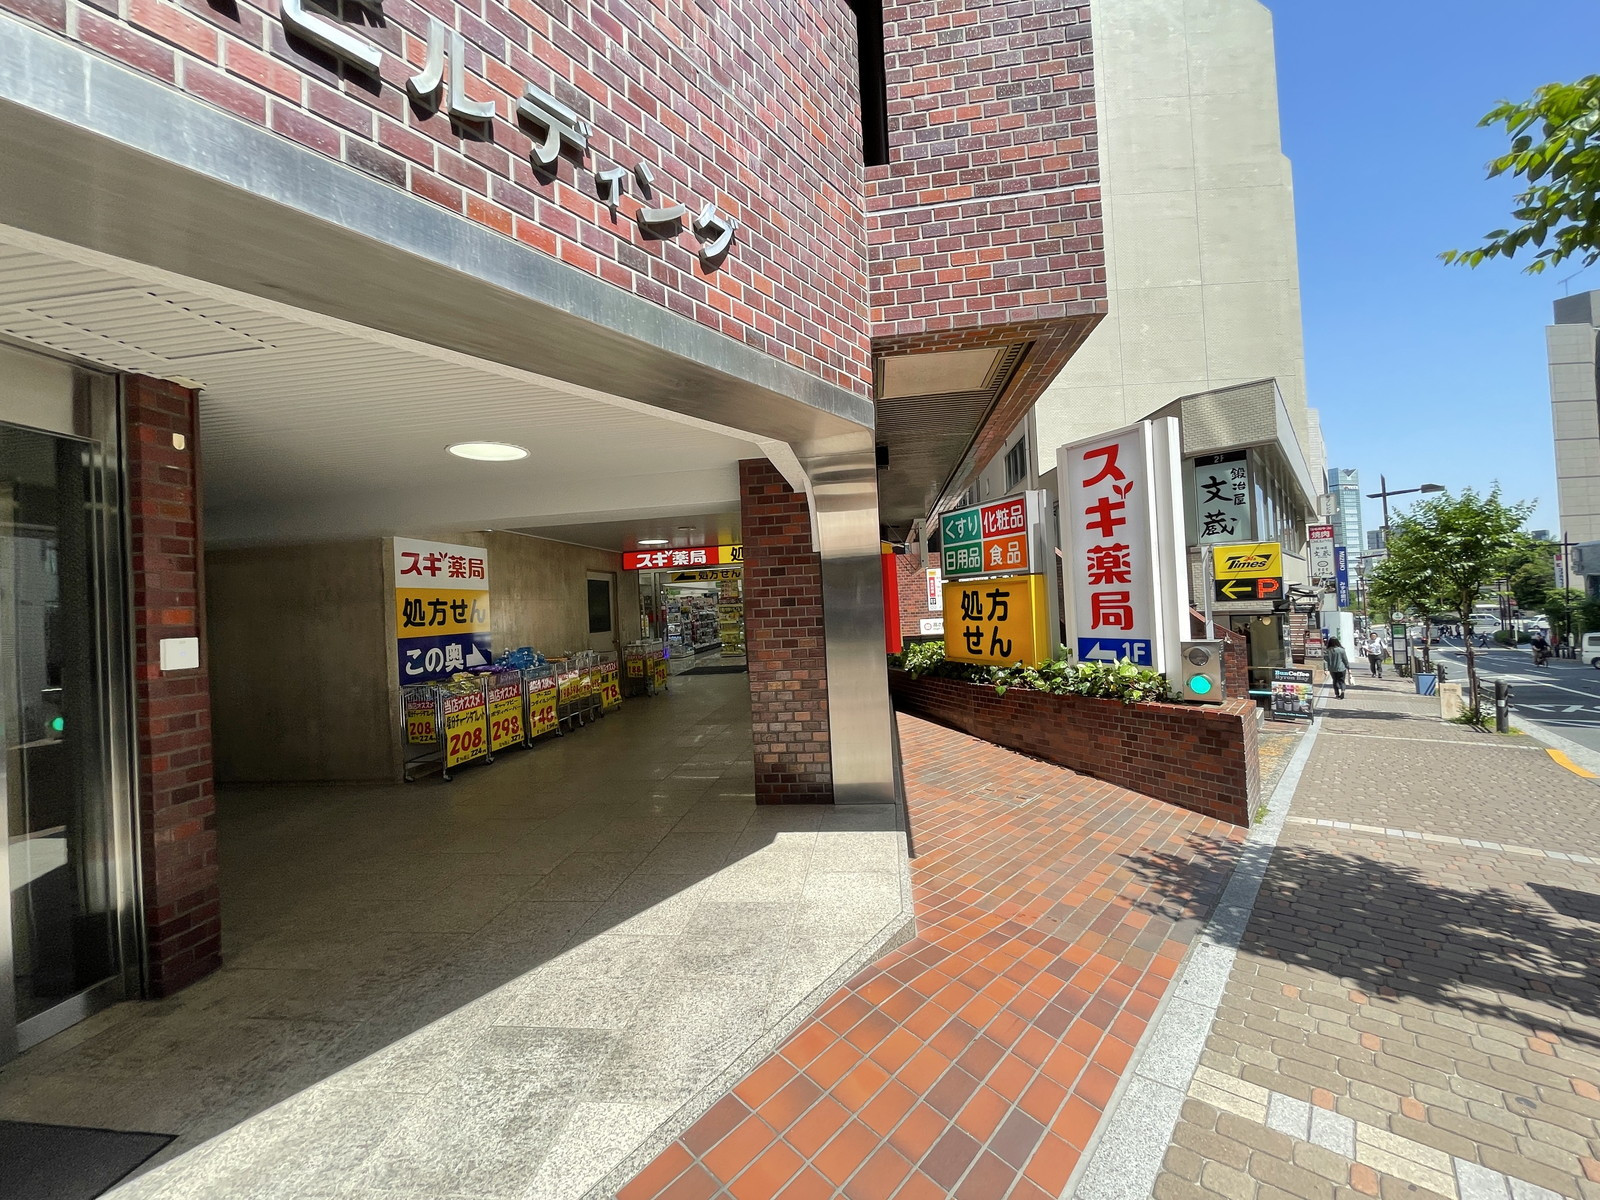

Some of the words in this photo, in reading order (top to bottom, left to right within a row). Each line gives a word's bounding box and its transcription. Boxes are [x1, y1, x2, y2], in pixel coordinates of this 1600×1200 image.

[1213, 455, 1225, 464] 2F
[1231, 467, 1246, 506] 鍛冶屋
[945, 514, 978, 539] くすり
[983, 504, 1024, 533] 化粧品
[1083, 444, 1134, 630] スギ薬局
[400, 551, 485, 580] スギ薬局
[636, 550, 707, 568] スギ薬局
[946, 547, 981, 571] 日用品
[989, 541, 1021, 566] 食品
[1225, 554, 1271, 570] Times
[1257, 578, 1280, 598] P
[403, 598, 485, 629] 処方せん
[960, 588, 1010, 622] 処方
[963, 625, 1012, 658] せん
[1122, 643, 1146, 661] 1F
[405, 643, 464, 676] この奥
